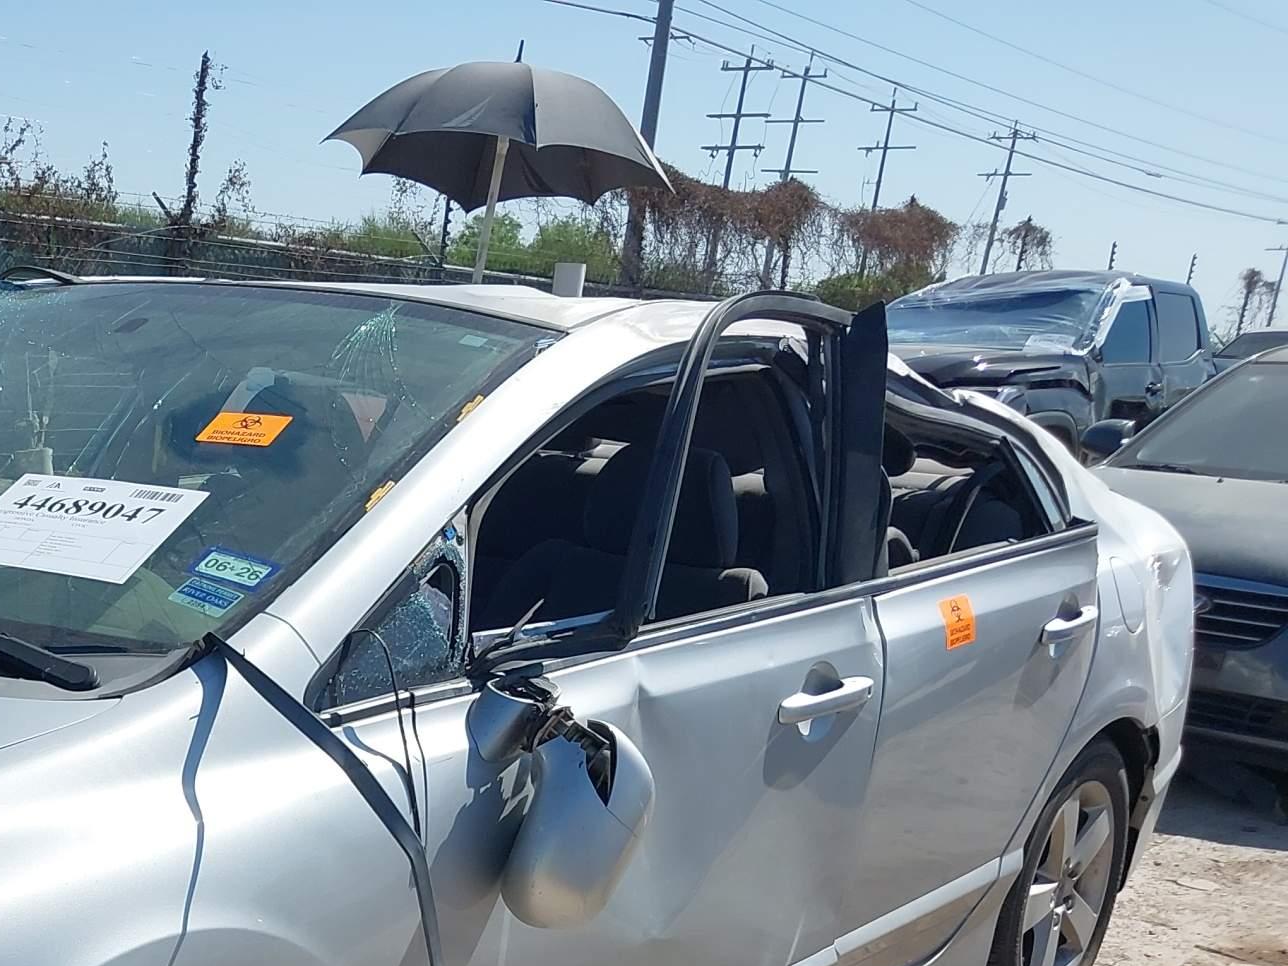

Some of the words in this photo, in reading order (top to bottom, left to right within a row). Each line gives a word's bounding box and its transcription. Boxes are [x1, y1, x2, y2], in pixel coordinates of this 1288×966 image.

[206, 435, 262, 444] BIOPELIGRO
[211, 429, 266, 438] BIOHAZARD
[13, 494, 167, 525] 44689047
[204, 558, 231, 572] 06
[235, 566, 263, 581] 26
[182, 586, 207, 600] RIVER
[206, 594, 230, 607] OAKS
